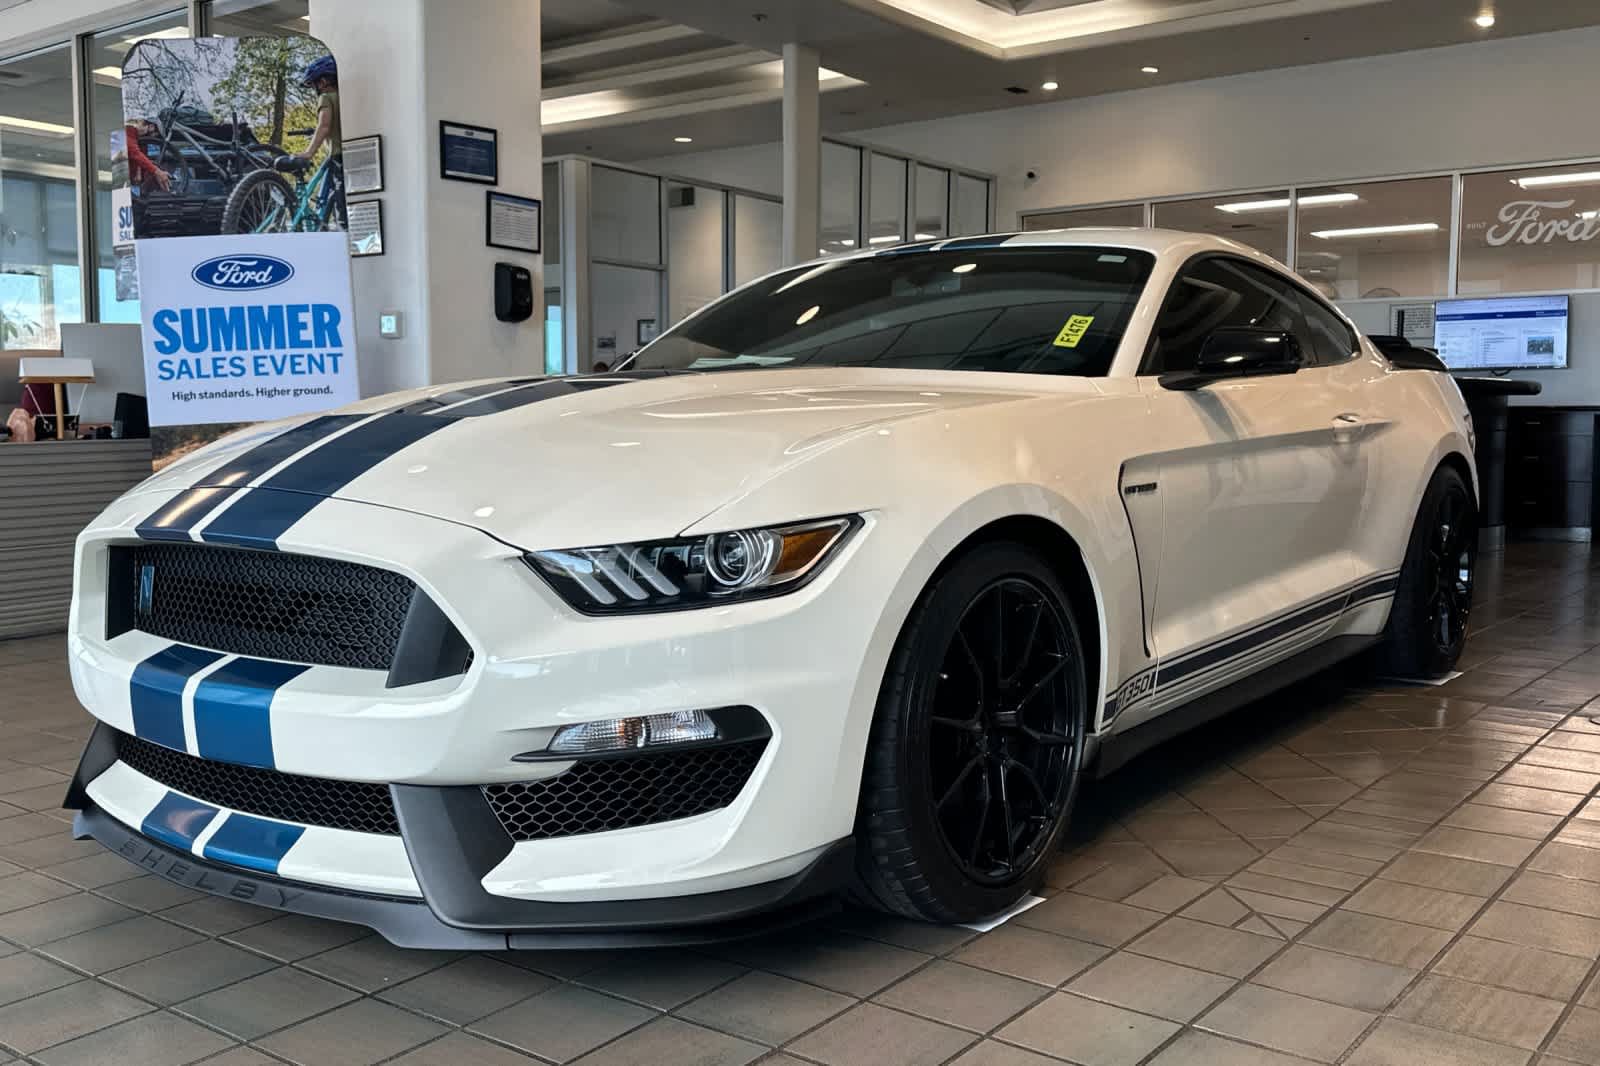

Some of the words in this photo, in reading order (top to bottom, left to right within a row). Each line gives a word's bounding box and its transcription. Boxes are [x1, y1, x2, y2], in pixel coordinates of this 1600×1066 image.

[1486, 199, 1600, 246] Ford
[212, 259, 273, 284] Ford
[153, 303, 343, 355] SUMMER
[1060, 318, 1089, 344] F1476
[158, 355, 246, 381] SALES
[253, 353, 343, 377] EVENT
[172, 391, 197, 402] High
[198, 388, 255, 400] standards.
[256, 386, 290, 399] Higher
[292, 385, 334, 398] ground.
[120, 838, 305, 908] SHELBY
